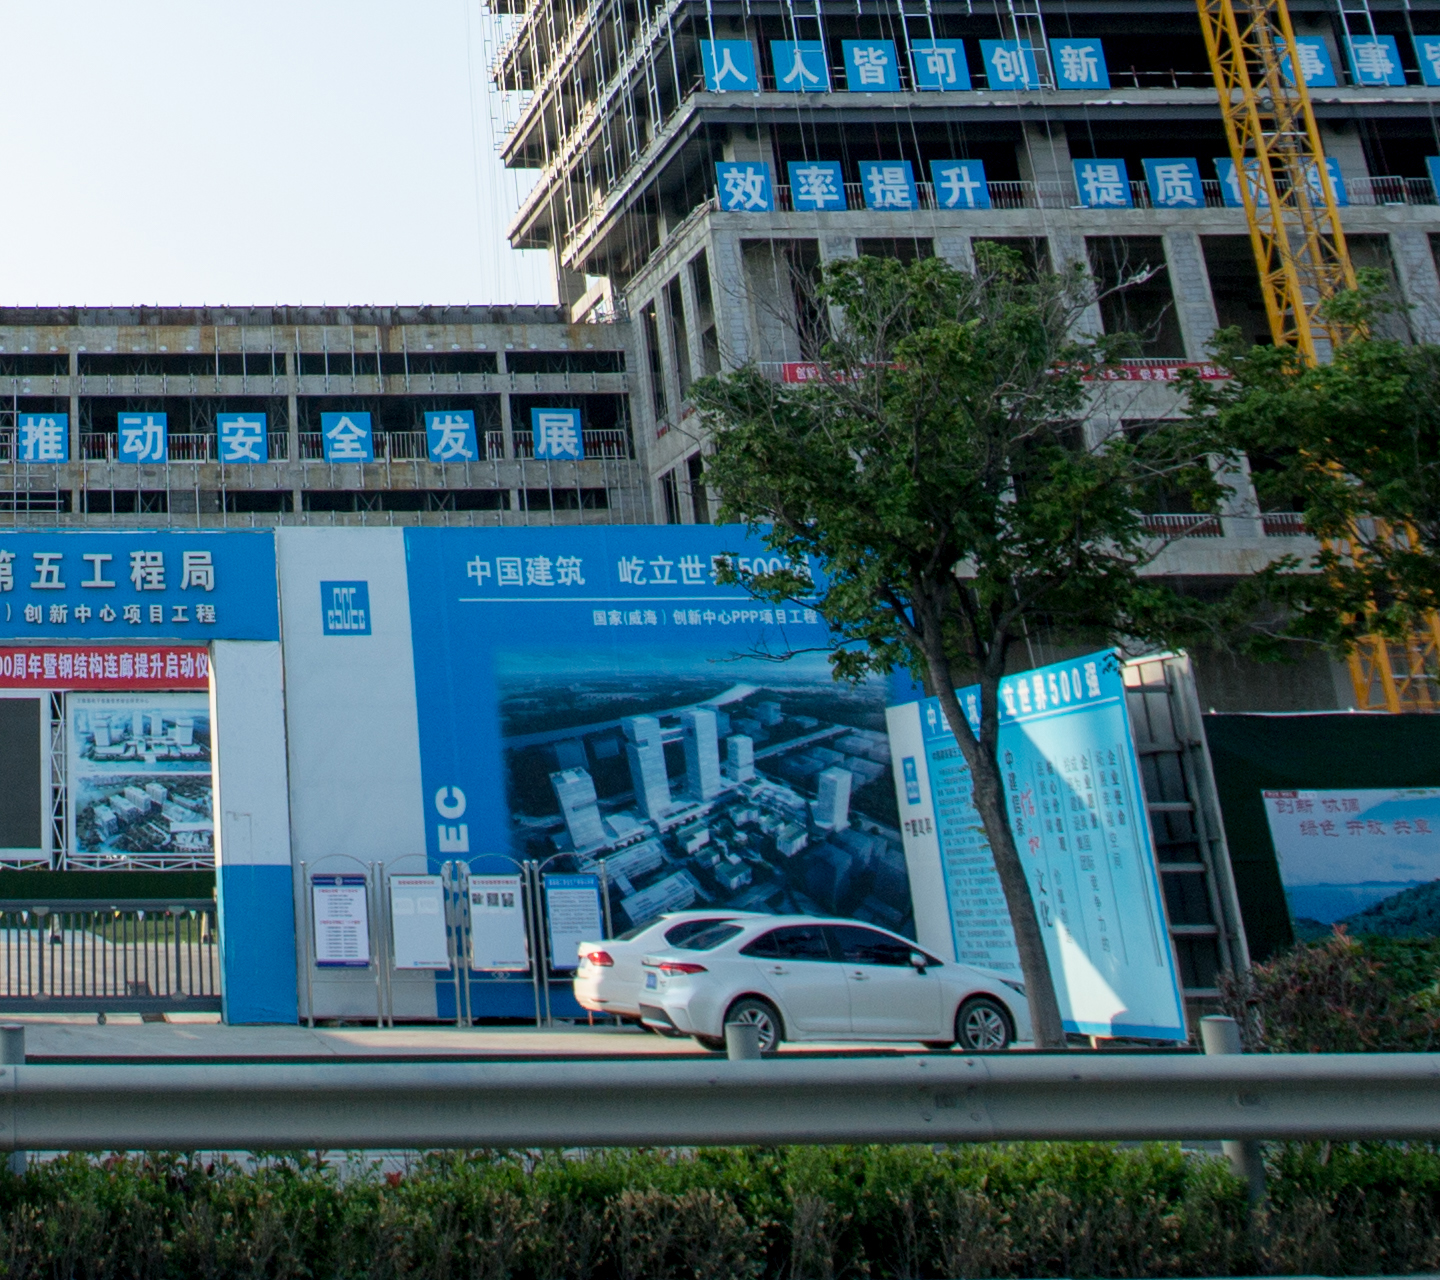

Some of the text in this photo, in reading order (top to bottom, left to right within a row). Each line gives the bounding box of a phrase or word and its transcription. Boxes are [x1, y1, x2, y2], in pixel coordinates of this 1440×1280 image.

[714, 44, 1098, 84] 人人皆可创新
[724, 165, 980, 209] 效率提升
[21, 413, 580, 461] 推动安全发展
[467, 555, 586, 587] 中国建筑
[1275, 798, 1314, 814] 创新
[1299, 819, 1340, 837] 绿色
